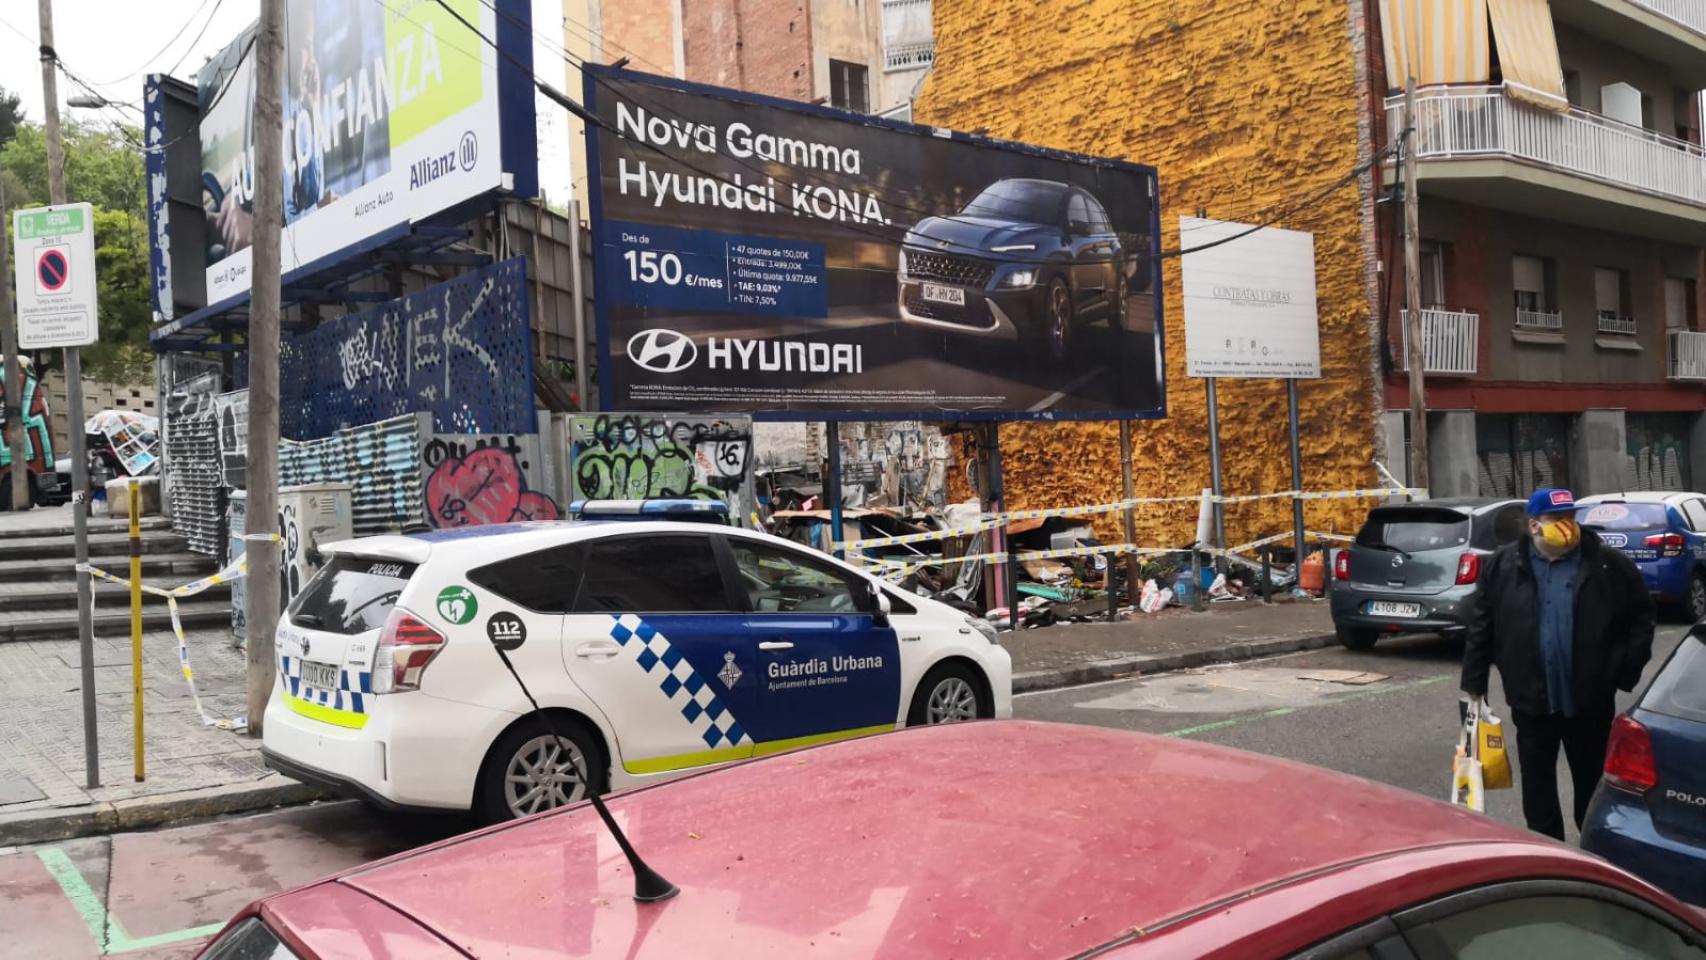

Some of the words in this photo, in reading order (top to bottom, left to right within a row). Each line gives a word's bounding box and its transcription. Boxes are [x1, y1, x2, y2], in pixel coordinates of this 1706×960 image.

[616, 101, 716, 154] Nova
[726, 121, 861, 175] Gamma
[409, 150, 457, 191] Allianz
[618, 157, 776, 213] Hyundai
[355, 201, 376, 218] Allianz
[378, 191, 394, 208] Auto
[621, 232, 638, 243] Des
[638, 234, 650, 244] de
[736, 245, 746, 254] 47
[746, 246, 771, 256] quotes
[772, 248, 781, 257] de
[782, 249, 809, 259] 150,00€
[623, 249, 683, 286] 150
[684, 273, 724, 289] €/mes
[738, 267, 762, 279] Última
[738, 281, 756, 292] TAE:
[739, 294, 754, 303] TIN:
[708, 336, 863, 374] HYUNDAI
[491, 620, 521, 636] 112
[768, 658, 828, 678] Guàrdia
[832, 655, 883, 672] Urbana
[768, 679, 807, 691] Ajuntament
[808, 677, 817, 686] de
[817, 675, 848, 685] Barcelona
[1666, 789, 1706, 806] POLO
